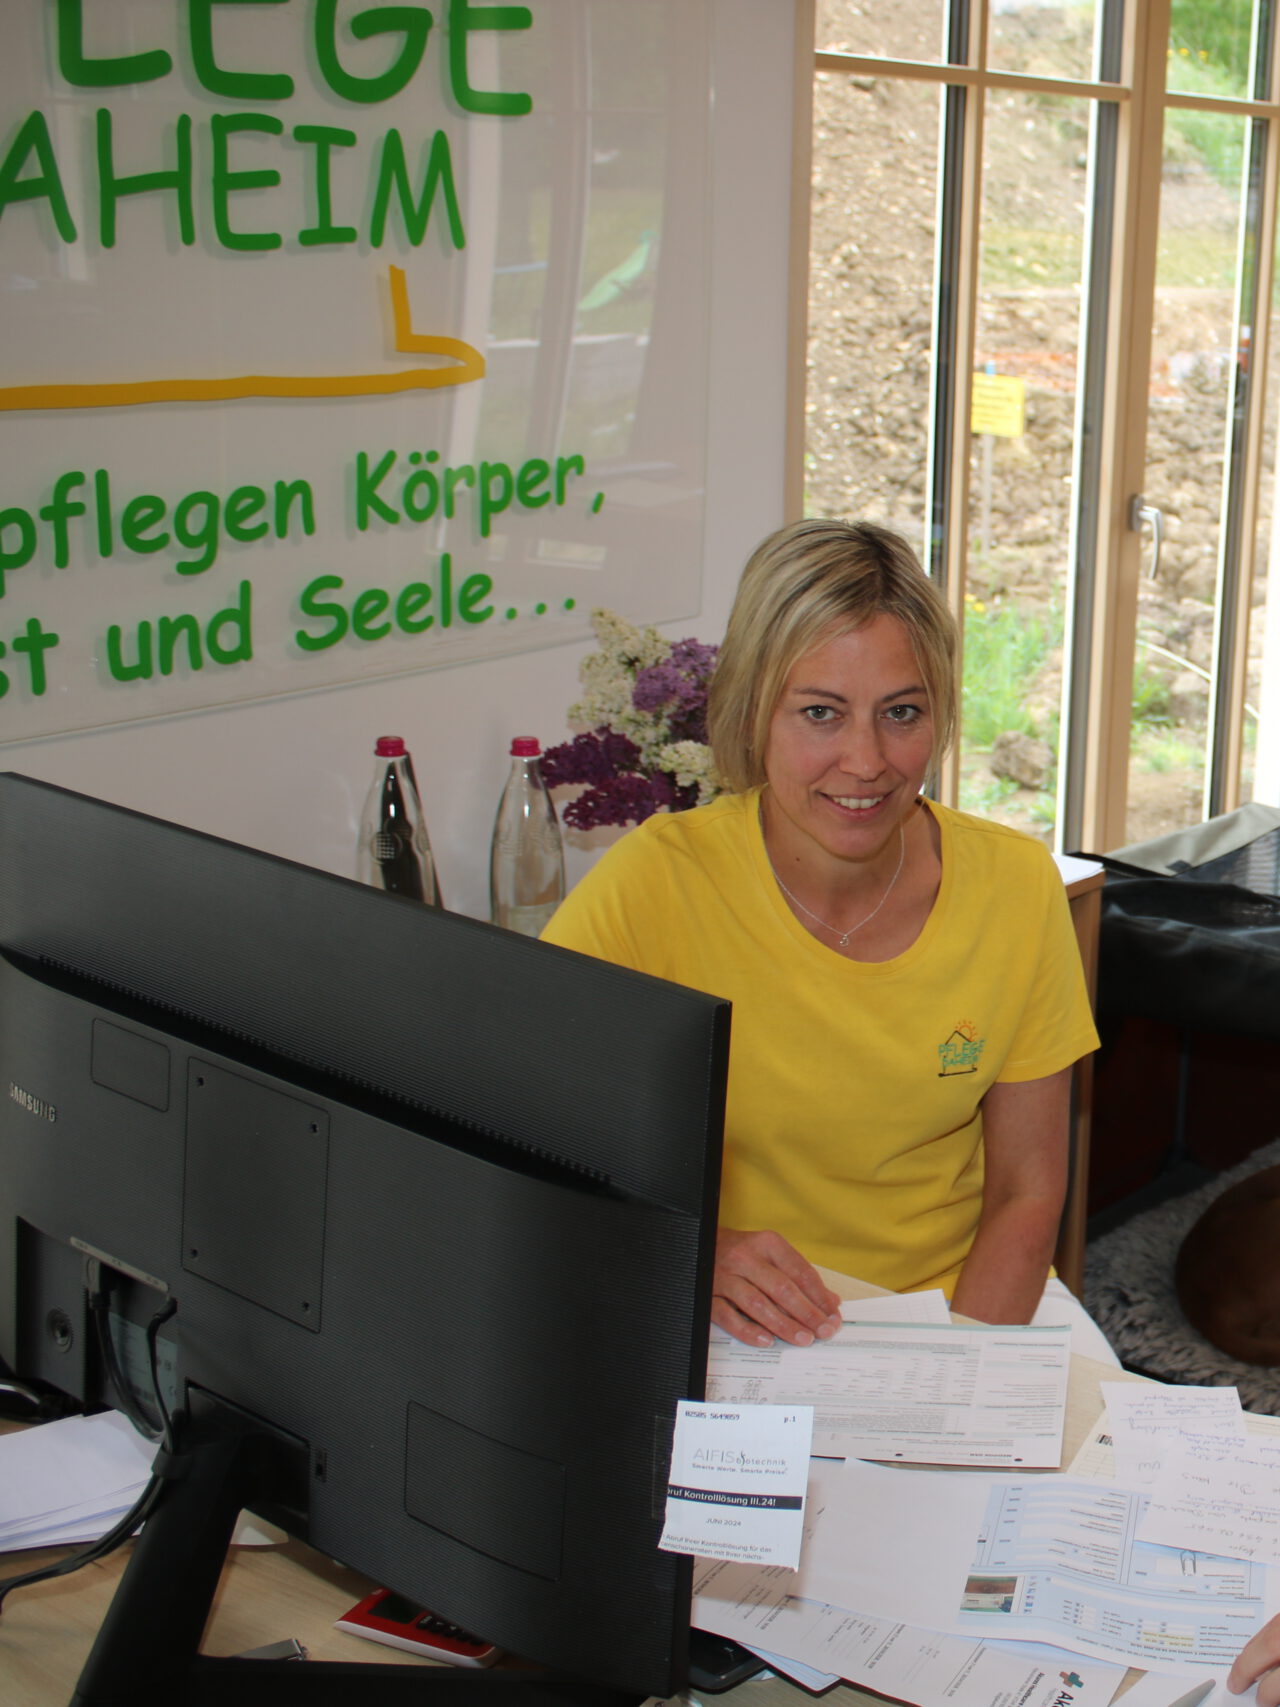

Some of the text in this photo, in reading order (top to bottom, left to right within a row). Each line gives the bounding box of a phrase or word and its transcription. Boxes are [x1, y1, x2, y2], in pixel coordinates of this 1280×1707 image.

[0, 109, 464, 250] AHEIM
[0, 450, 603, 597] pflegen Körper,
[106, 580, 251, 680] und
[295, 553, 574, 650] Seele...
[9, 1081, 56, 1122] SAMSUNG
[693, 1447, 735, 1464] AIFIS
